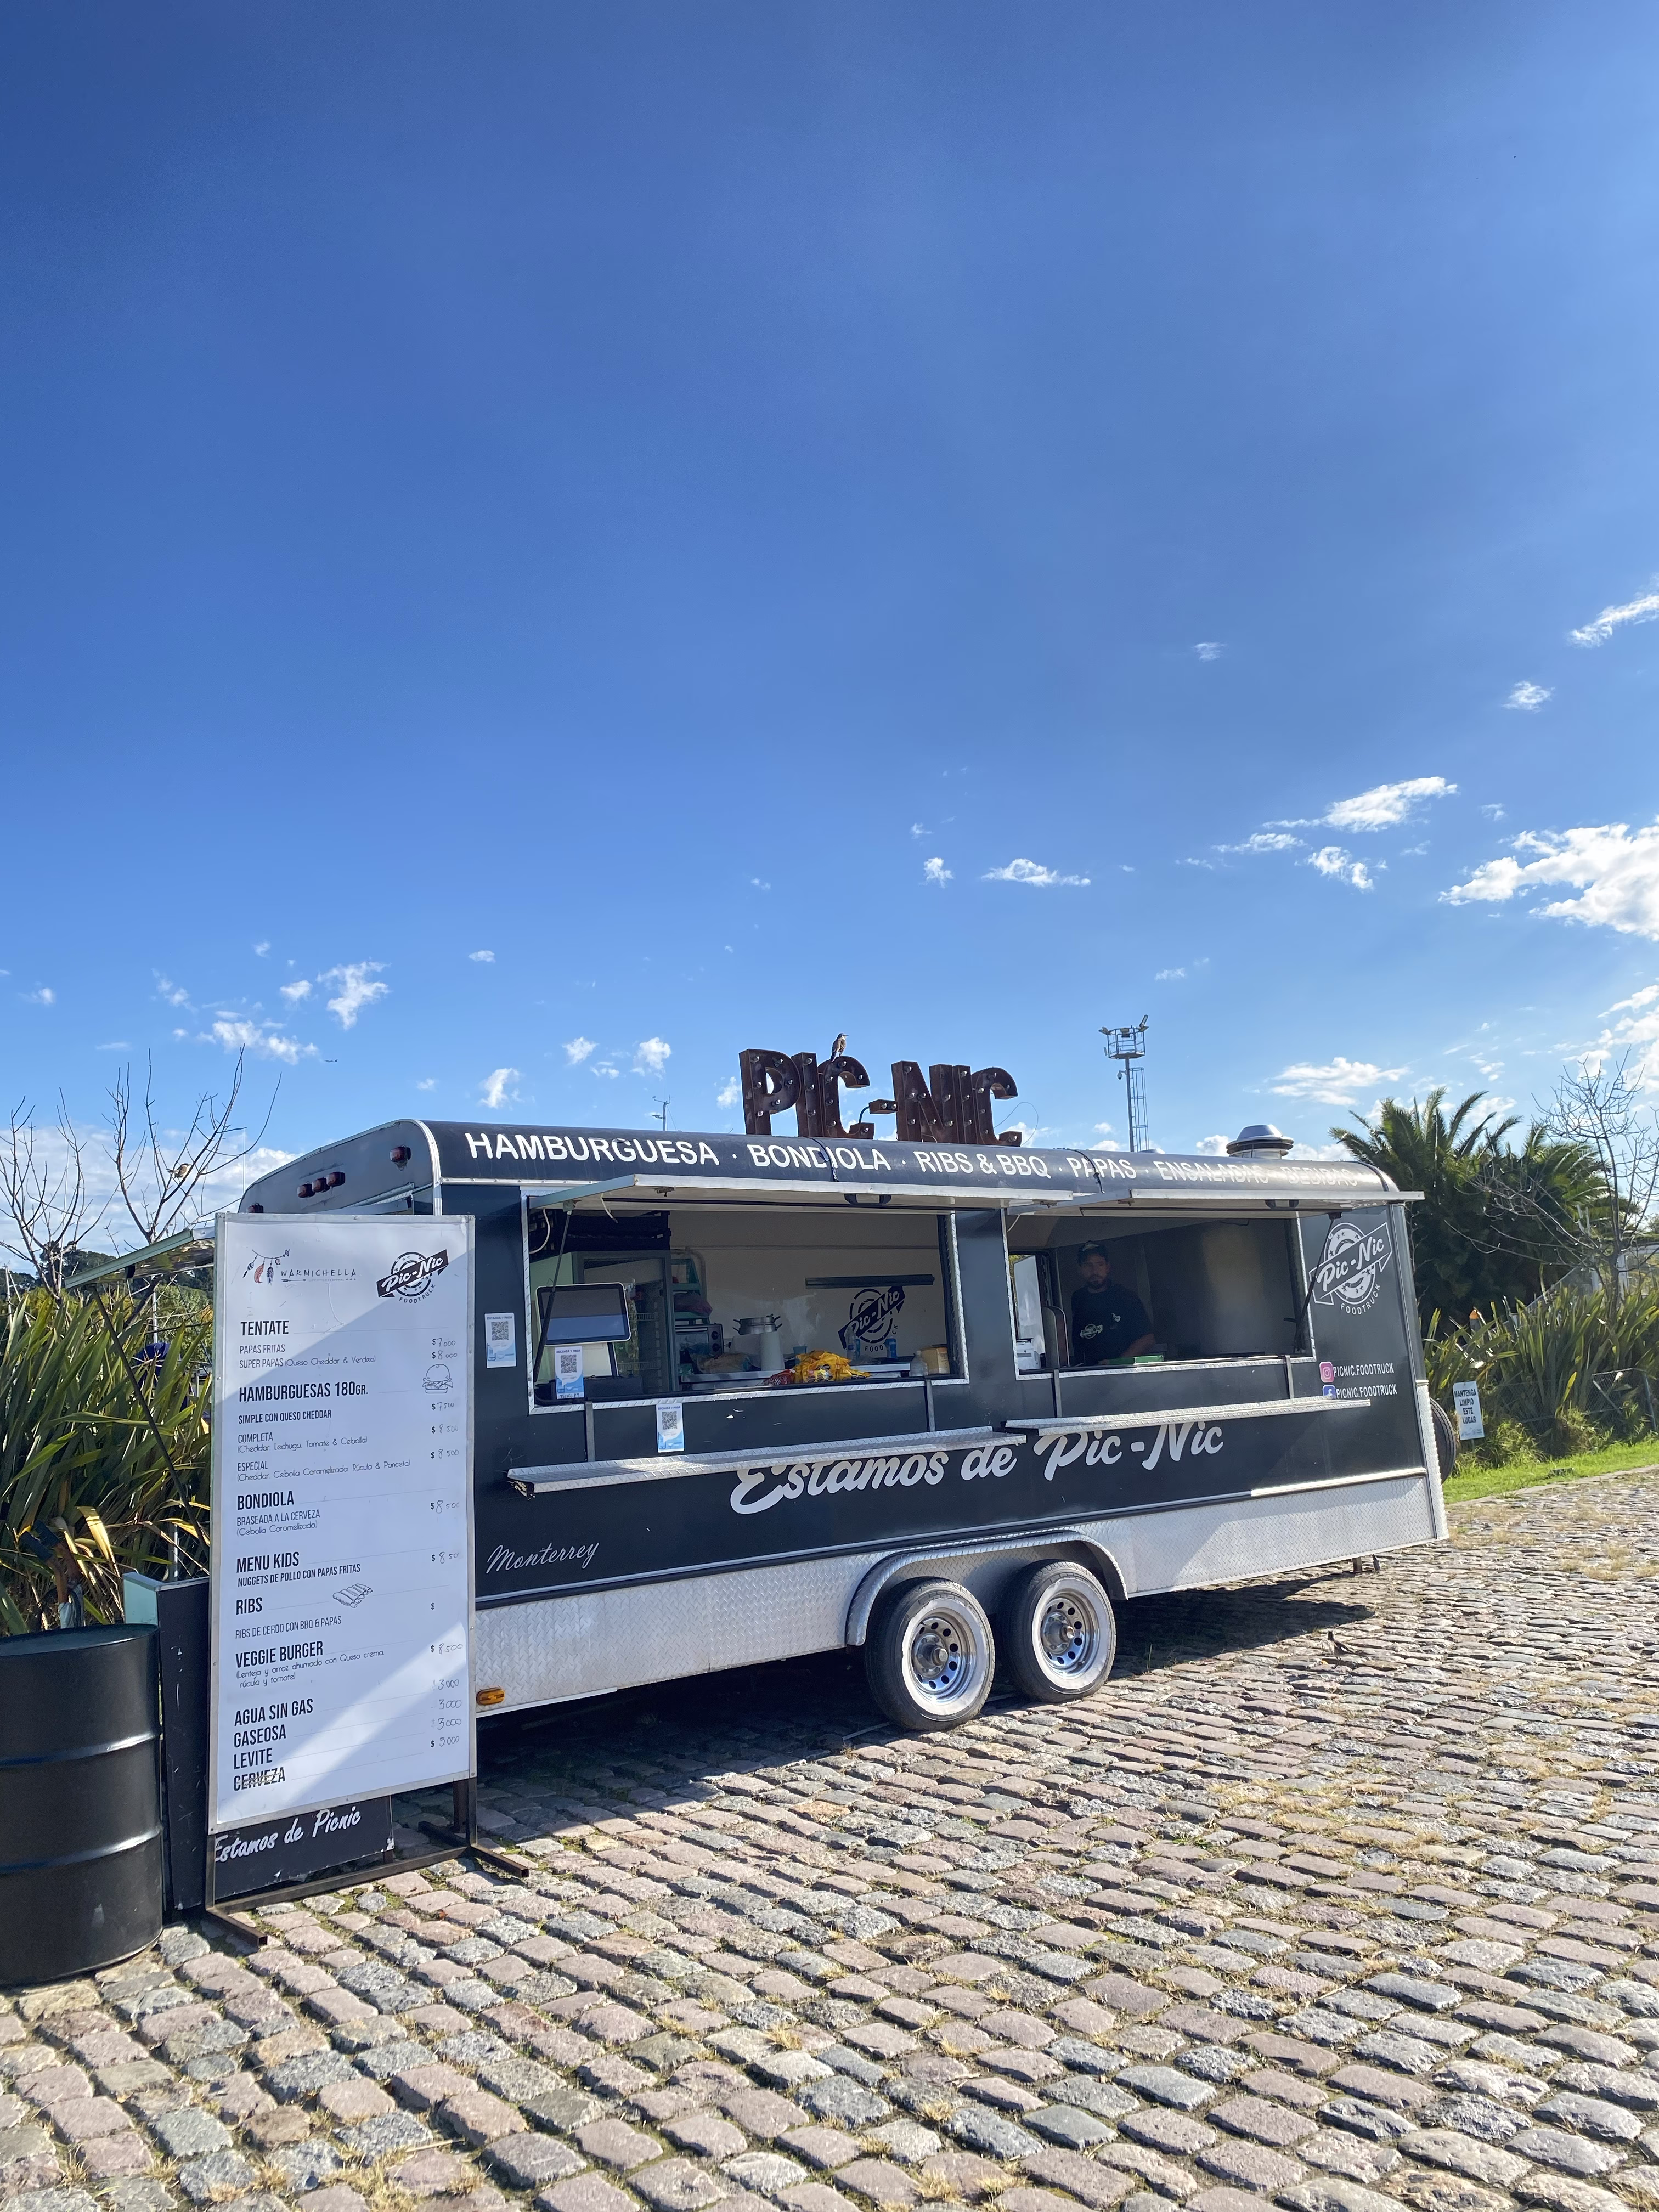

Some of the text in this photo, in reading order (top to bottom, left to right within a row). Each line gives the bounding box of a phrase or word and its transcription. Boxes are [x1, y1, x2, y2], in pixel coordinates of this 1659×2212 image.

[739, 1048, 1022, 1147] PIC-NIC
[464, 1132, 720, 1166] HAMBURGUESA
[747, 1143, 891, 1171] BONDIOLA
[914, 1150, 973, 1174] RIBS
[980, 1154, 997, 1175] &
[995, 1154, 1051, 1180] BBQ
[1066, 1156, 1137, 1180] PAPAS
[1153, 1160, 1269, 1184] ENSALADAS
[281, 1268, 356, 1278] WARMICHELLA
[1317, 1236, 1385, 1292] Pic-Nic
[381, 1257, 444, 1292] Pic-Nic
[399, 1284, 436, 1304] FOODTRUCK
[1340, 1283, 1381, 1315] FOODTRUCK
[240, 1320, 289, 1336] TENTATE
[240, 1344, 285, 1355] PAPAS FRITAS
[239, 1359, 261, 1369] SUPER
[262, 1358, 284, 1367] PAPAS
[284, 1358, 308, 1368] (Queso
[311, 1357, 340, 1366] Cheddar
[351, 1355, 376, 1363] Verdeo)
[1333, 1362, 1395, 1378] PICNIC.FOODTRUCK
[239, 1381, 369, 1402] HAMBURGUESAS 180GR.
[1335, 1384, 1397, 1399] PICNIC.FOODTRUCK
[1454, 1389, 1477, 1398] MANTENGA
[1459, 1398, 1474, 1407] LIMPIO
[238, 1409, 332, 1424] SIMPLE CON QUESO CHEDDAR
[1462, 1416, 1477, 1424] LUGAR
[238, 1432, 273, 1443] COMPLETA
[306, 1439, 329, 1448] Tomate
[341, 1436, 368, 1446] Cebolla)
[238, 1460, 268, 1472] ESPECIAL
[273, 1469, 300, 1479] Cebolla
[352, 1463, 373, 1472] Rúcula
[383, 1459, 410, 1469] Panceta)
[730, 1421, 1224, 1515] Estamos de Pic-Nic
[236, 1490, 295, 1510] BONDIOLA
[236, 1509, 320, 1526] BRASEADA A LA CERVEZA
[236, 1520, 318, 1537] (Cebolla Caramelizada)
[236, 1551, 300, 1573] MENU KIDS
[486, 1542, 600, 1574] Monterrey
[238, 1564, 360, 1587] NUGGETS DE POLLO CON PAPAS FRITAS
[236, 1596, 263, 1616] RIBS
[235, 1616, 342, 1639] RIBS DE CERDO CON BBQ & PAPAS
[235, 1640, 324, 1668] VEGGIE BURGER
[236, 1669, 262, 1681] (Lenteja
[272, 1665, 289, 1674] arroz
[291, 1660, 323, 1671] ahumado
[340, 1653, 360, 1662] Queso
[240, 1678, 260, 1689] rúcula
[271, 1673, 296, 1684] tomate)
[234, 1698, 313, 1726] AGUA SIN GAS
[234, 1724, 286, 1748] GASEOSA
[234, 1747, 273, 1769] LEVITE
[233, 1767, 286, 1791] CERVEZA
[215, 1805, 362, 1863] Estamos de Picnic
